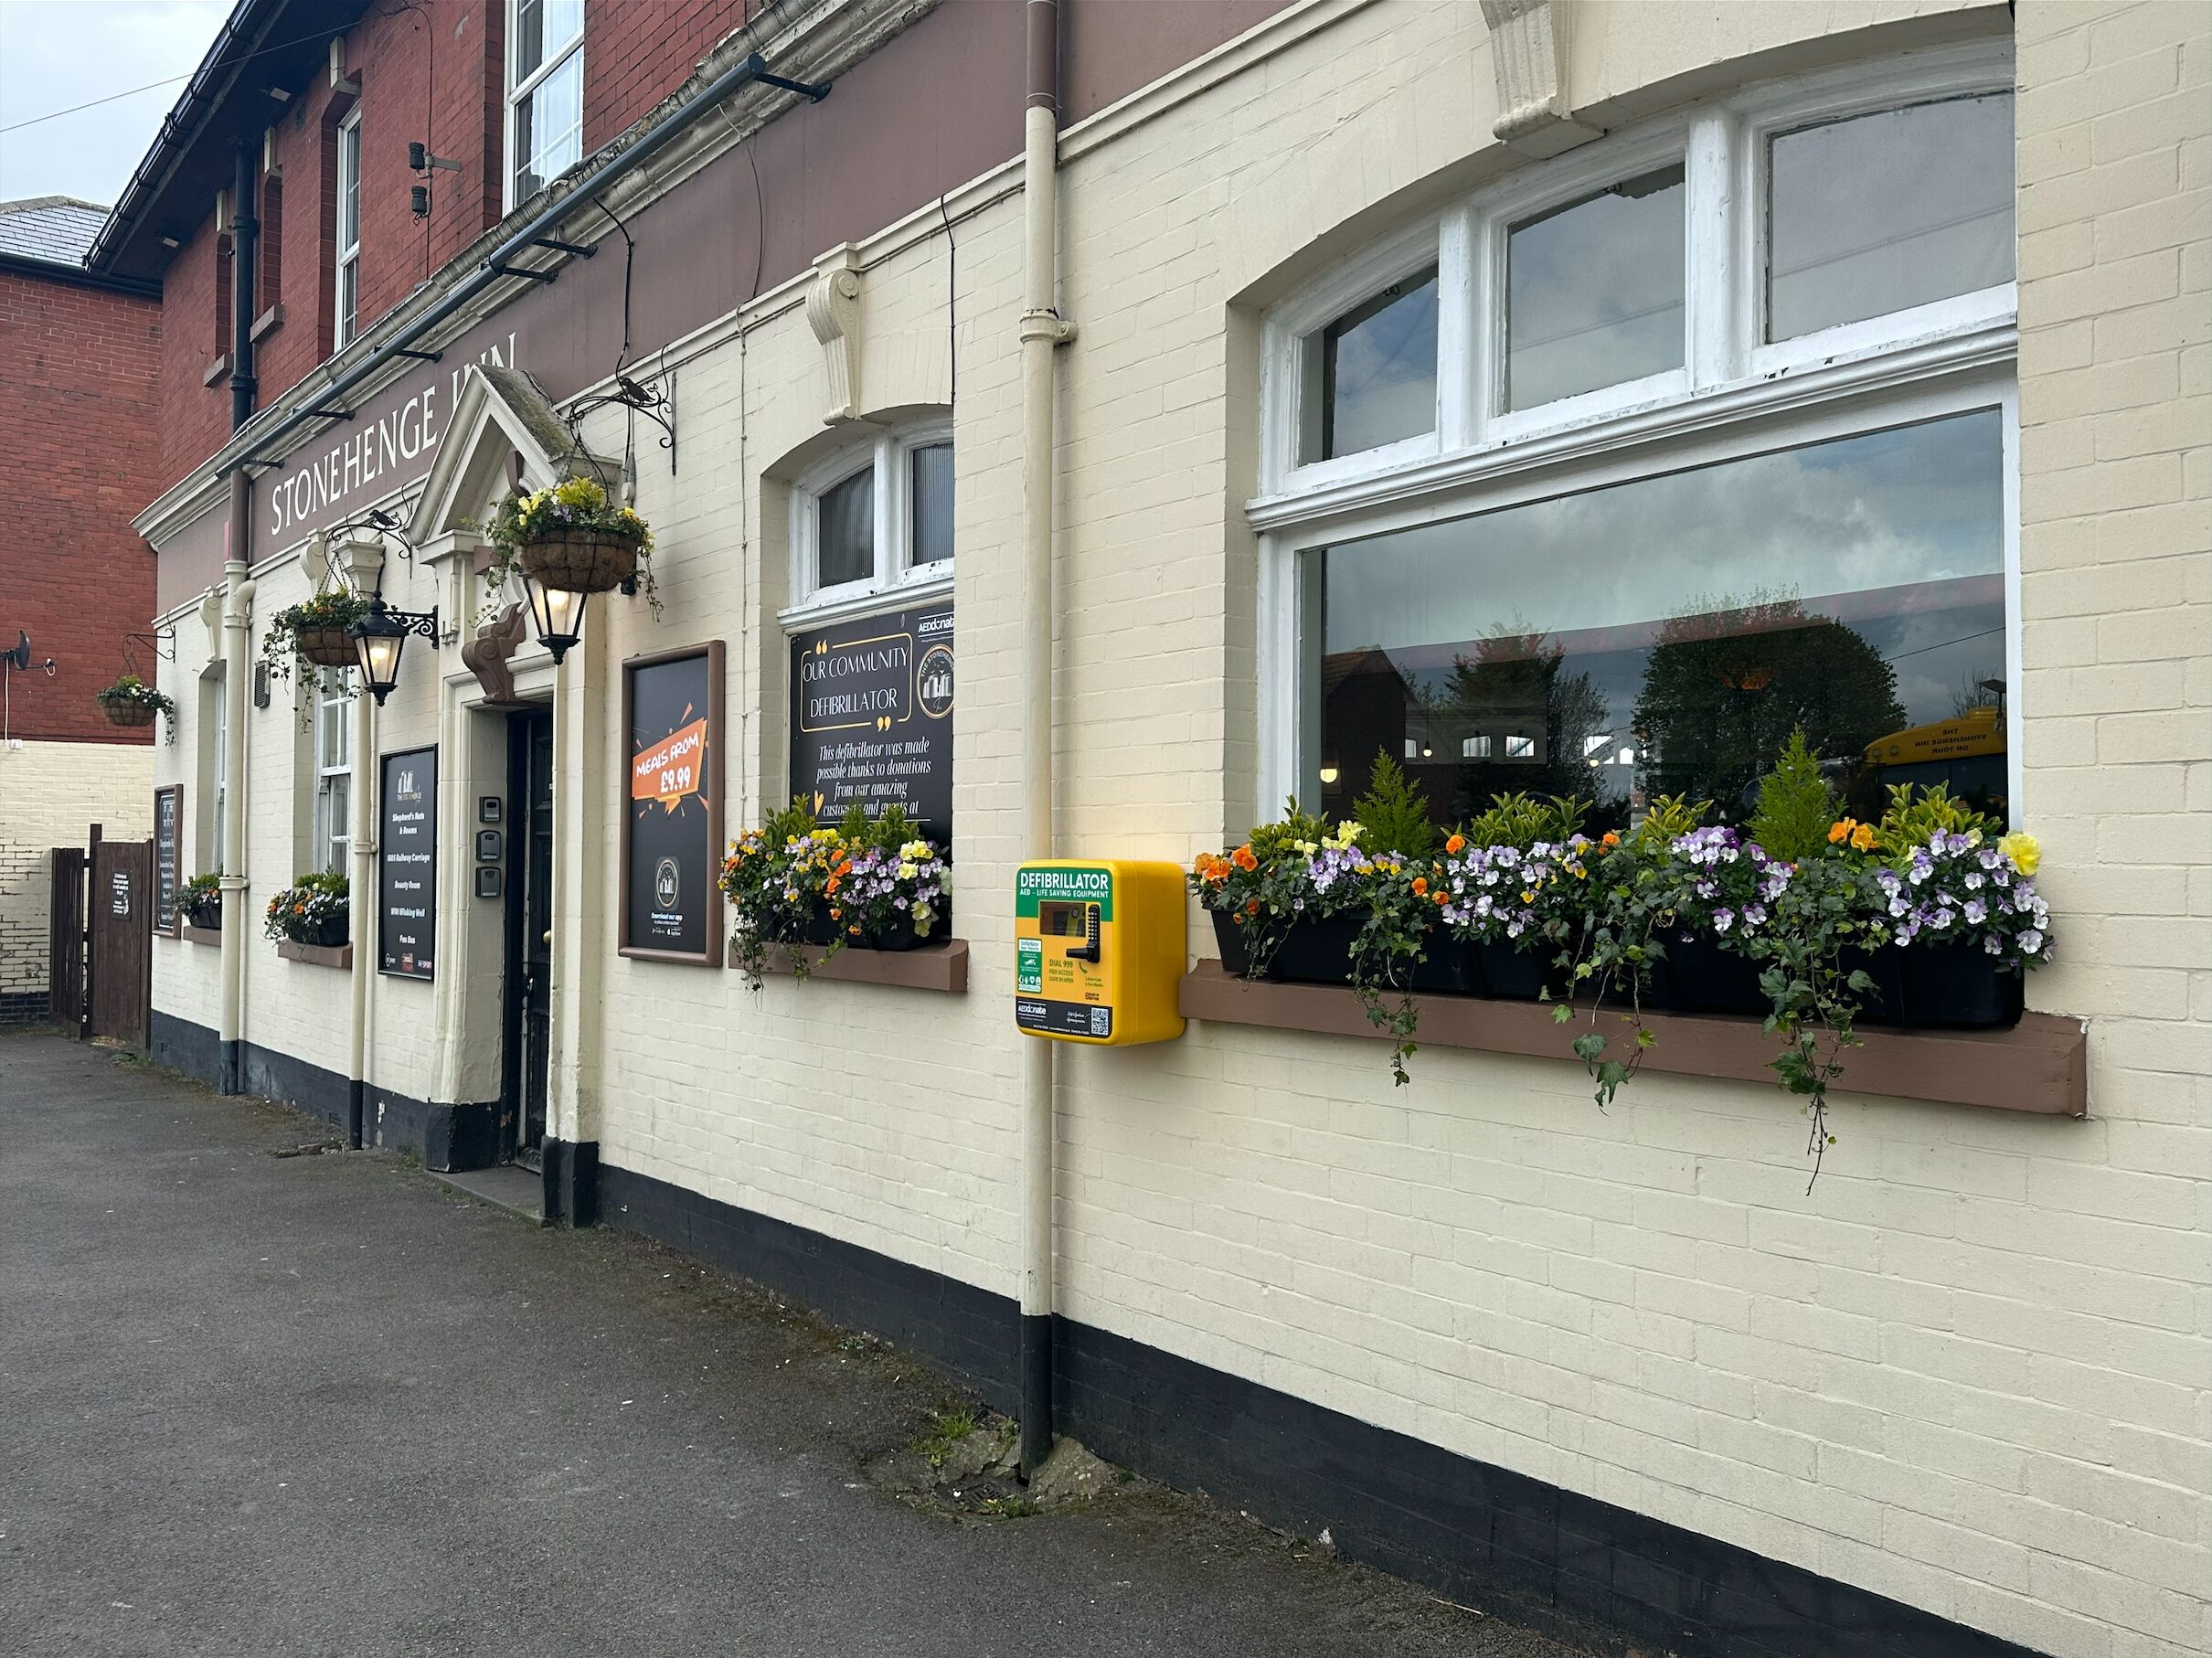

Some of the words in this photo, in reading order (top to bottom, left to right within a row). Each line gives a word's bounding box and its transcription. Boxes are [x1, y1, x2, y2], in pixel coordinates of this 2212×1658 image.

[271, 385, 438, 536] STONEHENGE
[803, 660, 826, 683] OUR
[828, 645, 909, 678] COMMUNITY
[810, 687, 899, 718] DEFIBRILLATOR
[636, 749, 669, 777] MEALS
[670, 732, 699, 761] FROM
[819, 744, 835, 761] This
[835, 741, 884, 764] defibrillator
[885, 741, 903, 757] was
[904, 736, 931, 754] made
[660, 766, 691, 793] £9.99
[816, 761, 846, 784] possible
[847, 760, 875, 778] thanks
[877, 762, 886, 777] to
[886, 757, 932, 776] donations
[834, 781, 854, 802] from
[855, 783, 870, 797] our
[870, 779, 909, 800] amazing
[863, 798, 879, 816] and
[909, 800, 920, 815] at
[1020, 872, 1109, 890] DEFIBRILLATOR
[1048, 889, 1071, 898] SAVING
[1072, 889, 1109, 898] EQUIPMENT
[1048, 959, 1062, 967] DIAL
[1062, 960, 1074, 969] 999
